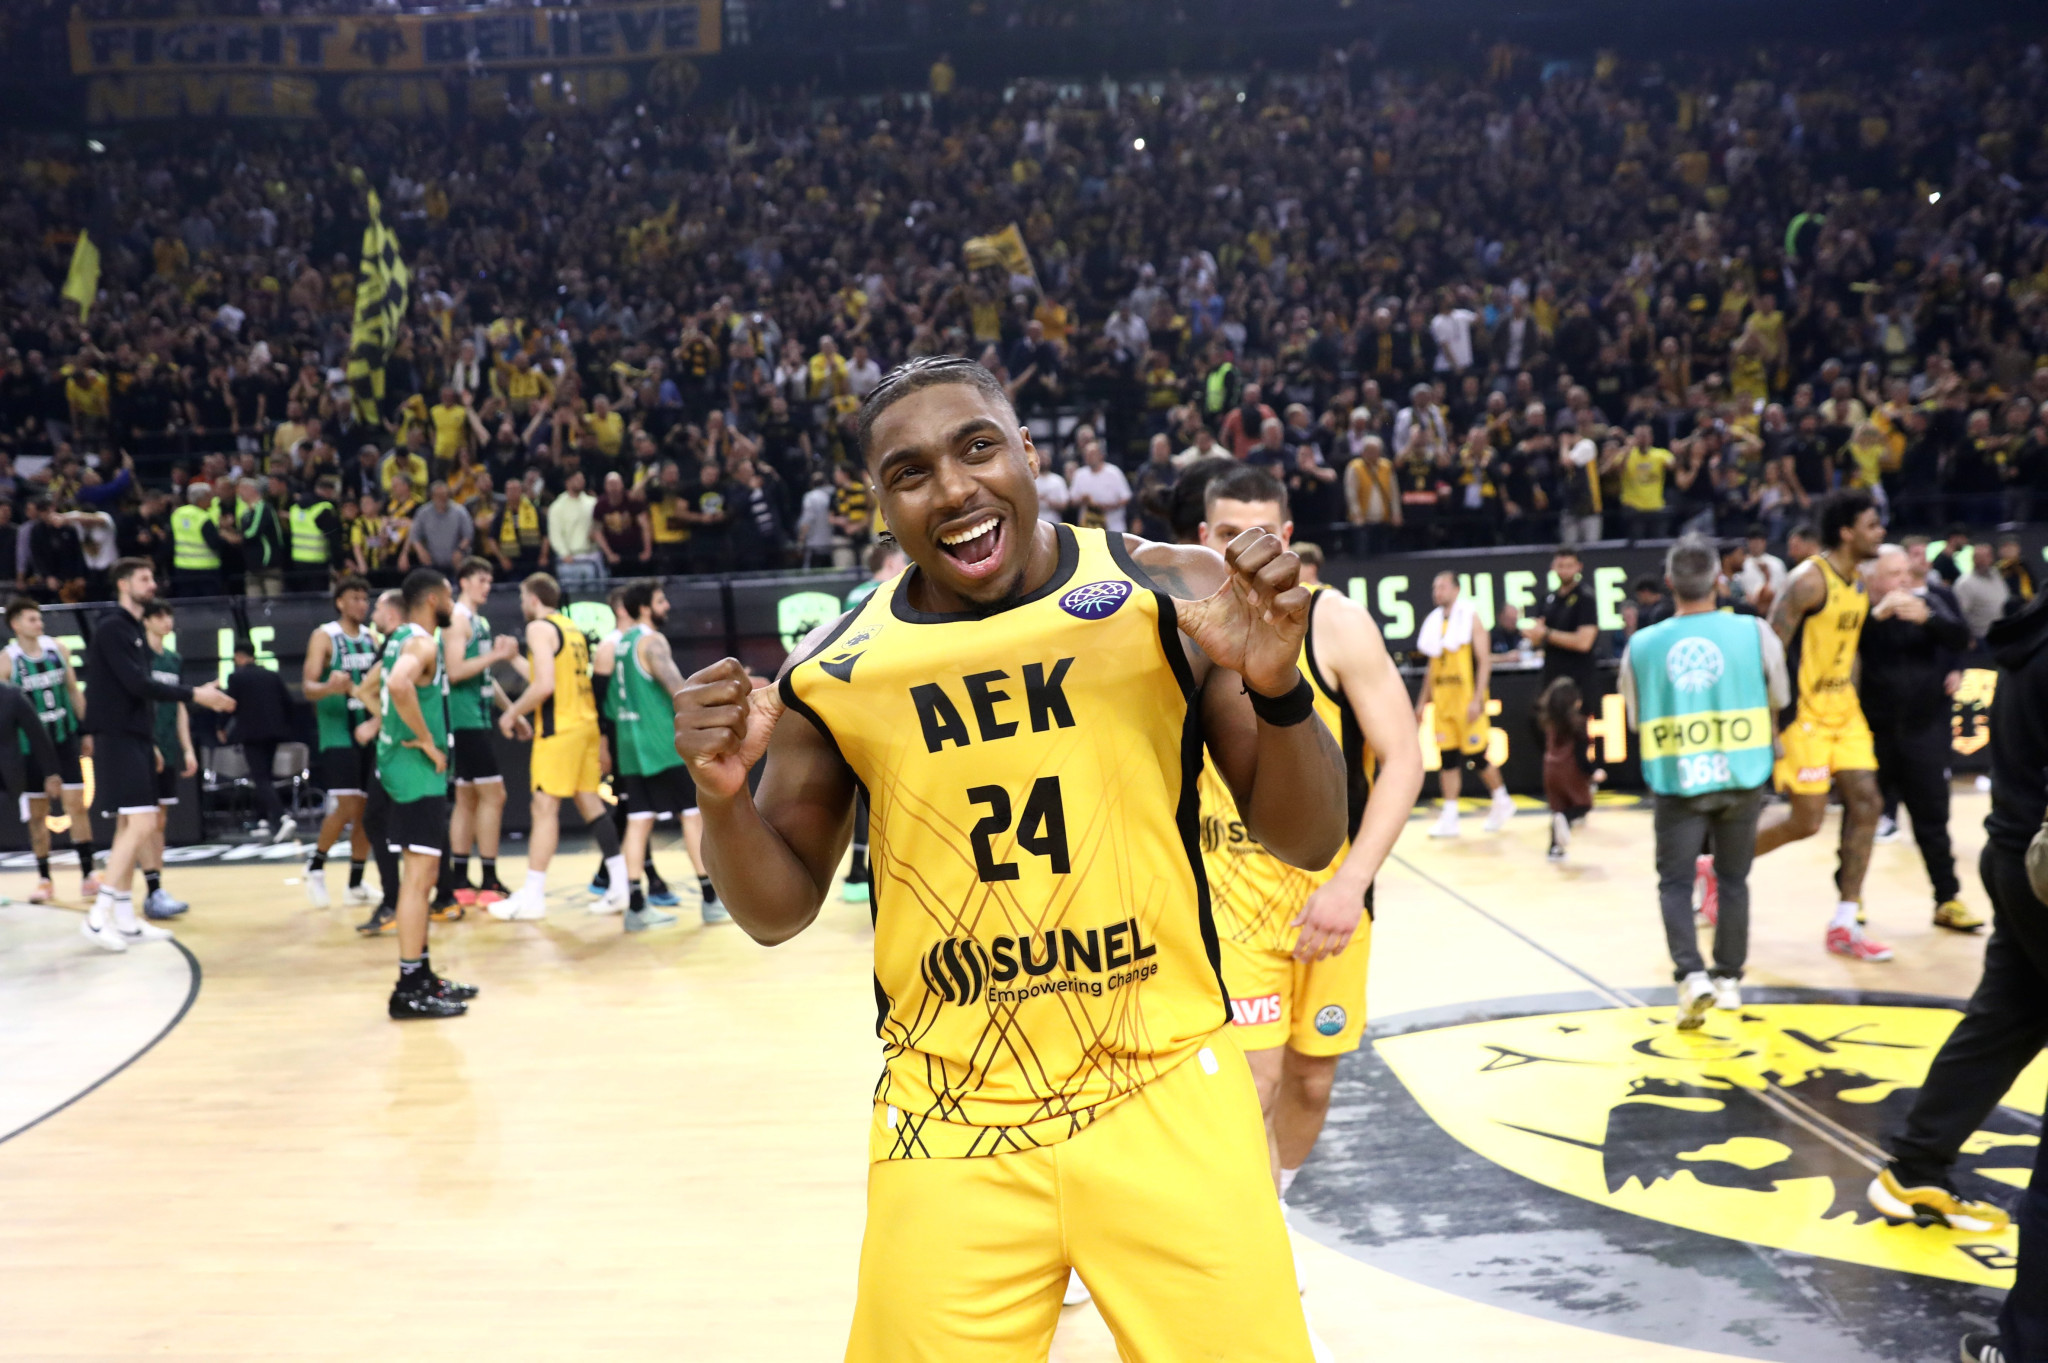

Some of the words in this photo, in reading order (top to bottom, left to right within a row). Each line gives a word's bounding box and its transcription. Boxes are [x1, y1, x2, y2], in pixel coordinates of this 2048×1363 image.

[88, 21, 338, 66] FIGHT
[421, 4, 699, 62] BELIEVE
[1458, 567, 1628, 633] HEE
[909, 656, 1076, 754] AEK
[1653, 716, 1752, 749] PHOTO
[968, 775, 1071, 883] 24
[990, 917, 1157, 982] SUNEL
[988, 978, 1102, 1003] Empowering
[1108, 962, 1158, 990] Change
[1231, 995, 1281, 1024] AVIS
